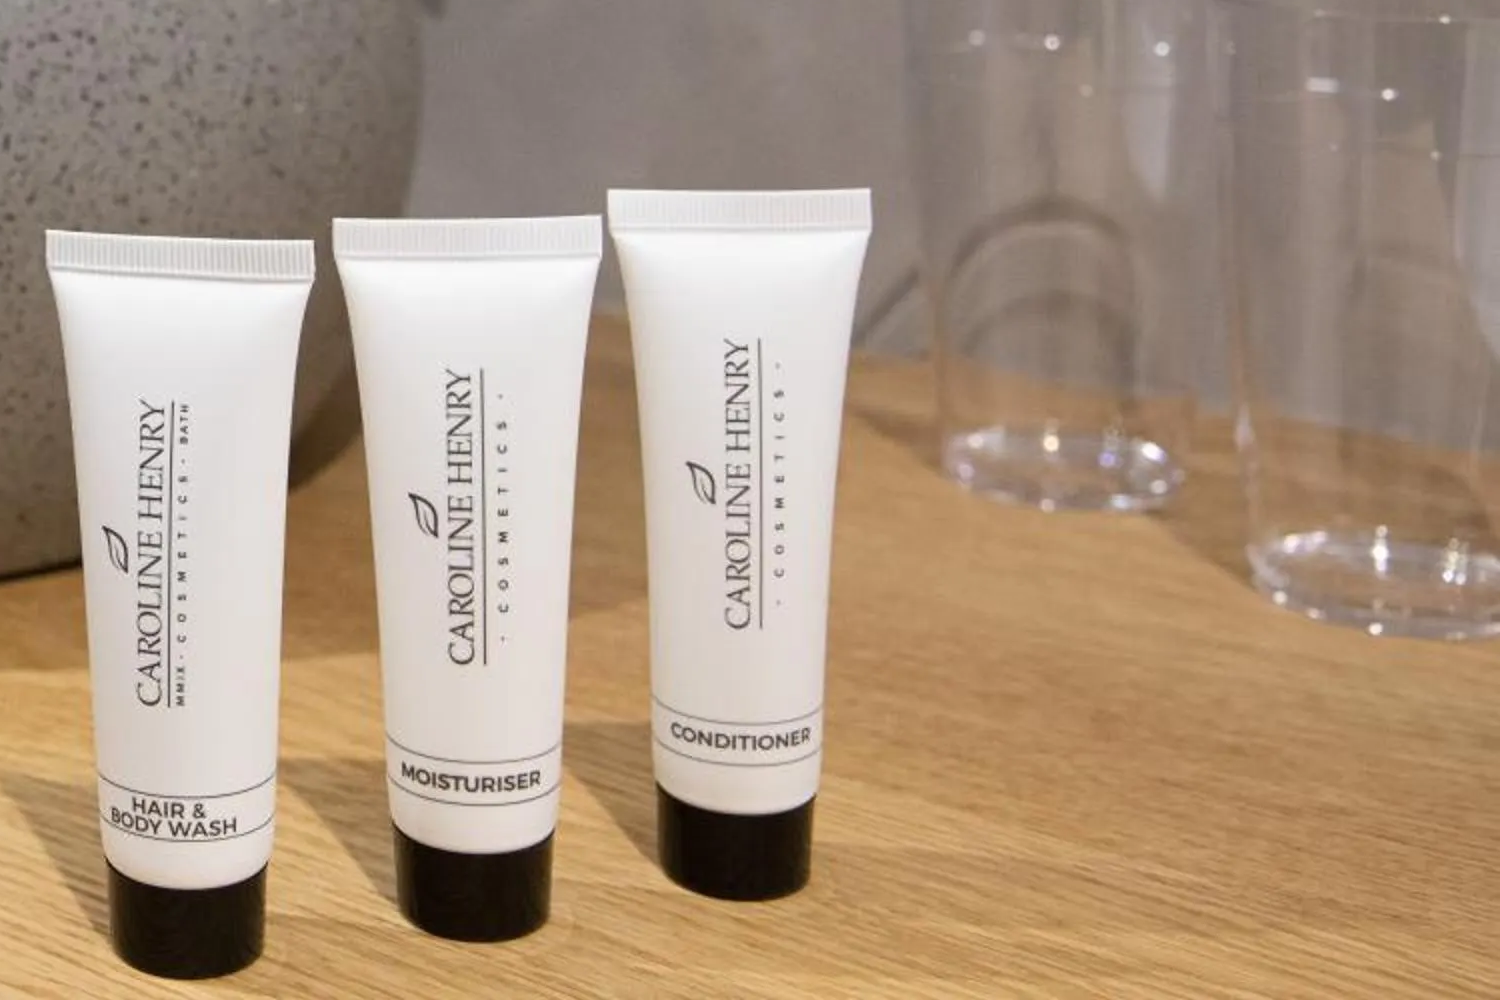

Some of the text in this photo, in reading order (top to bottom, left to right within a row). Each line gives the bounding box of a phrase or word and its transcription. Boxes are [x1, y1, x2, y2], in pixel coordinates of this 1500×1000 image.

[179, 404, 190, 445] BATH
[723, 338, 752, 631] CAROLINE HENRY
[773, 389, 786, 578] COSMETICS
[136, 399, 166, 707] CAROLINE HENRY
[176, 475, 189, 643] COSMETICS
[445, 368, 476, 667] CAROLINE HENRY
[496, 421, 509, 614] COSMETICS
[131, 797, 207, 819] HAIR &
[401, 761, 541, 794] MOISTURISER
[671, 722, 812, 752] CONDITIONER
[111, 807, 238, 838] BODY WASH
